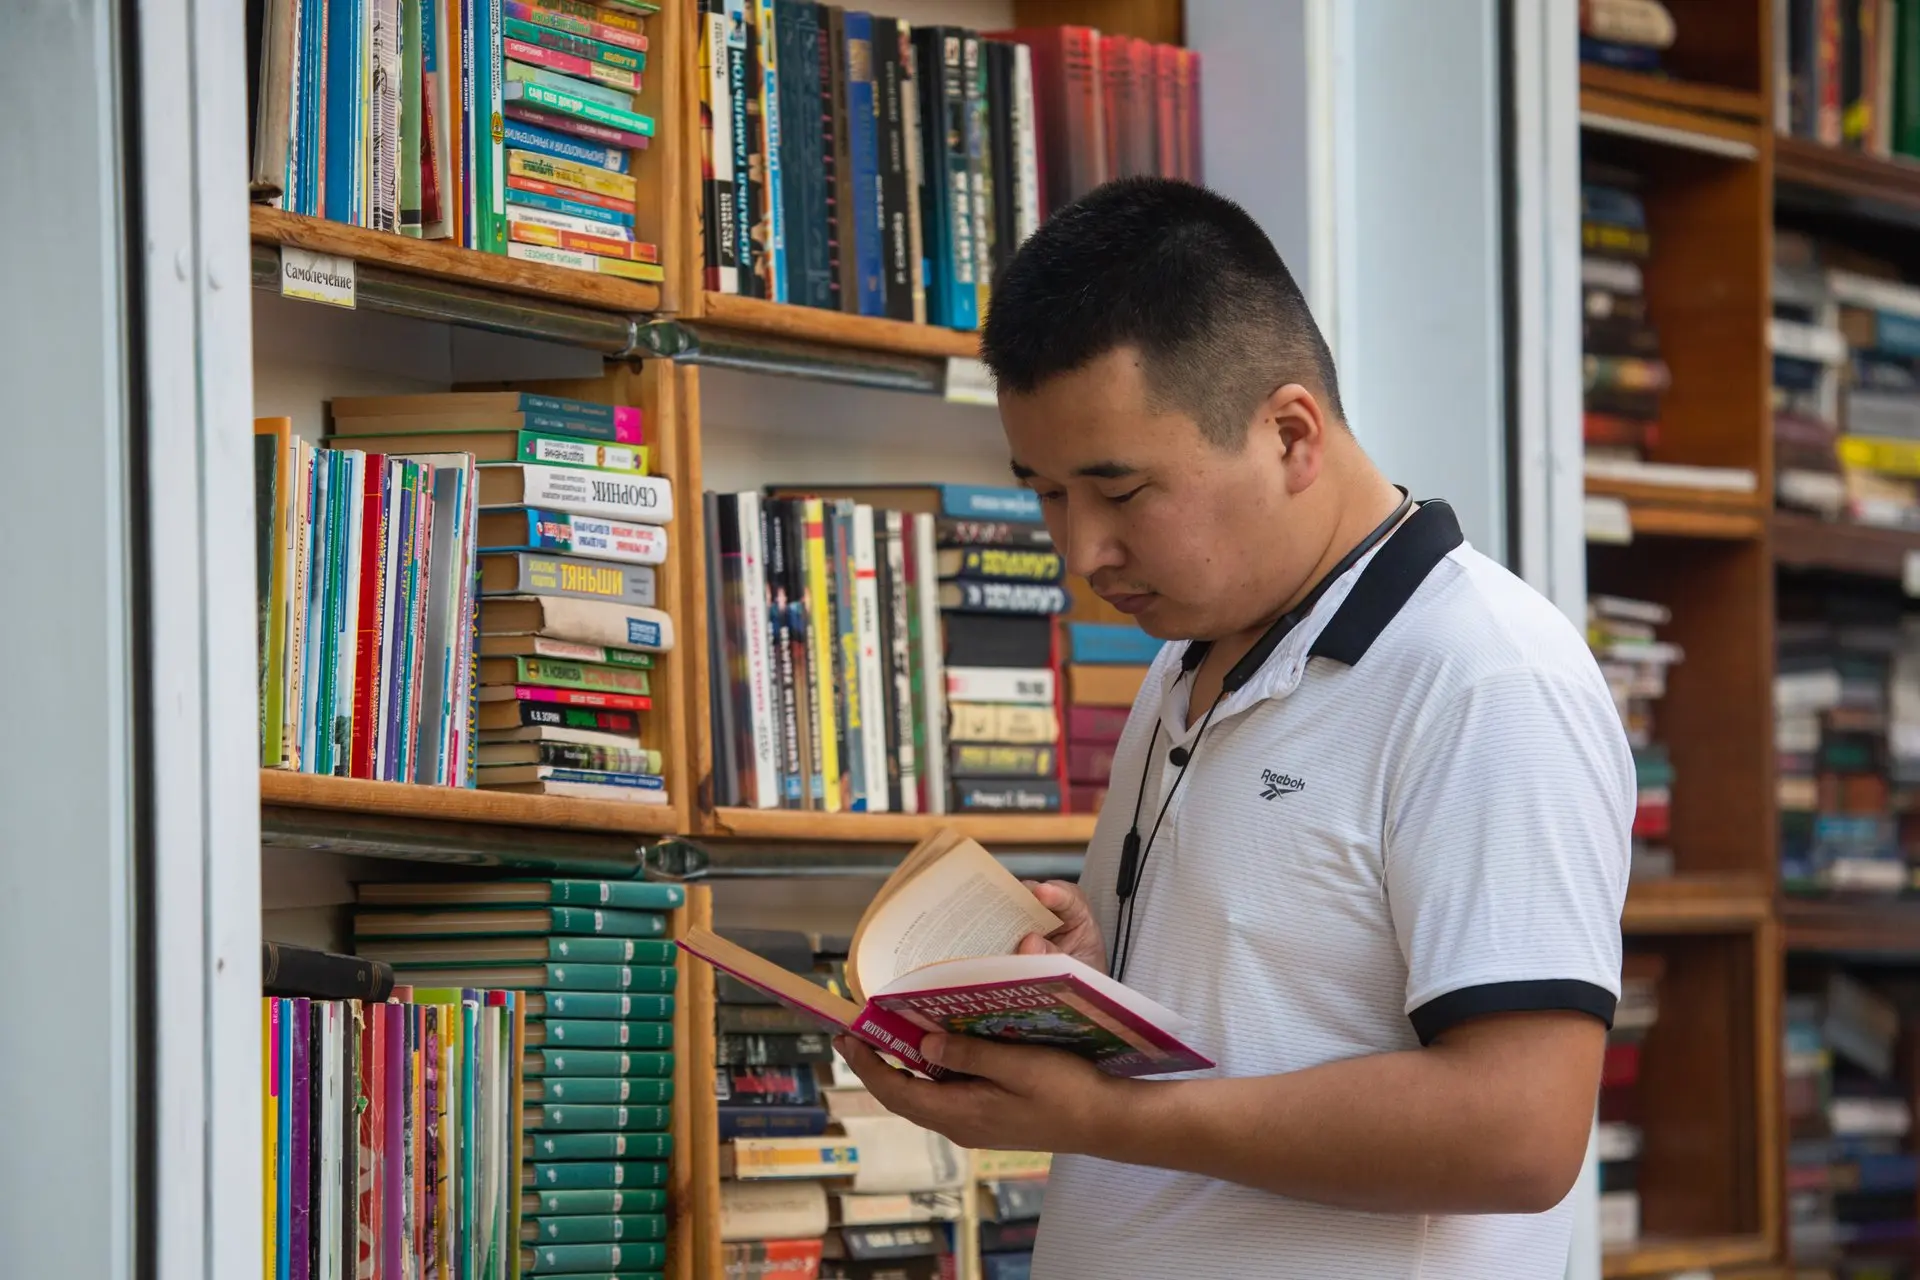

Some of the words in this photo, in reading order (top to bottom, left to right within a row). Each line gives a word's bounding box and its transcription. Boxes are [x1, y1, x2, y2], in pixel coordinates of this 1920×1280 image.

[732, 49, 747, 166] ГАМИЛЬТОН
[736, 171, 751, 266] ДОНАЛЬД
[285, 262, 352, 289] Самолечение
[592, 480, 657, 508] СБОРНИК
[560, 563, 624, 596] ТЯНЬШИ
[1261, 768, 1306, 791] Reebok
[909, 985, 1043, 1009] ГЕННАДИЙ
[923, 994, 1058, 1017] МАЛАХОВ
[861, 1019, 894, 1045] МАЛАХОВ
[890, 1037, 924, 1064] ГЕННАДИЙ
